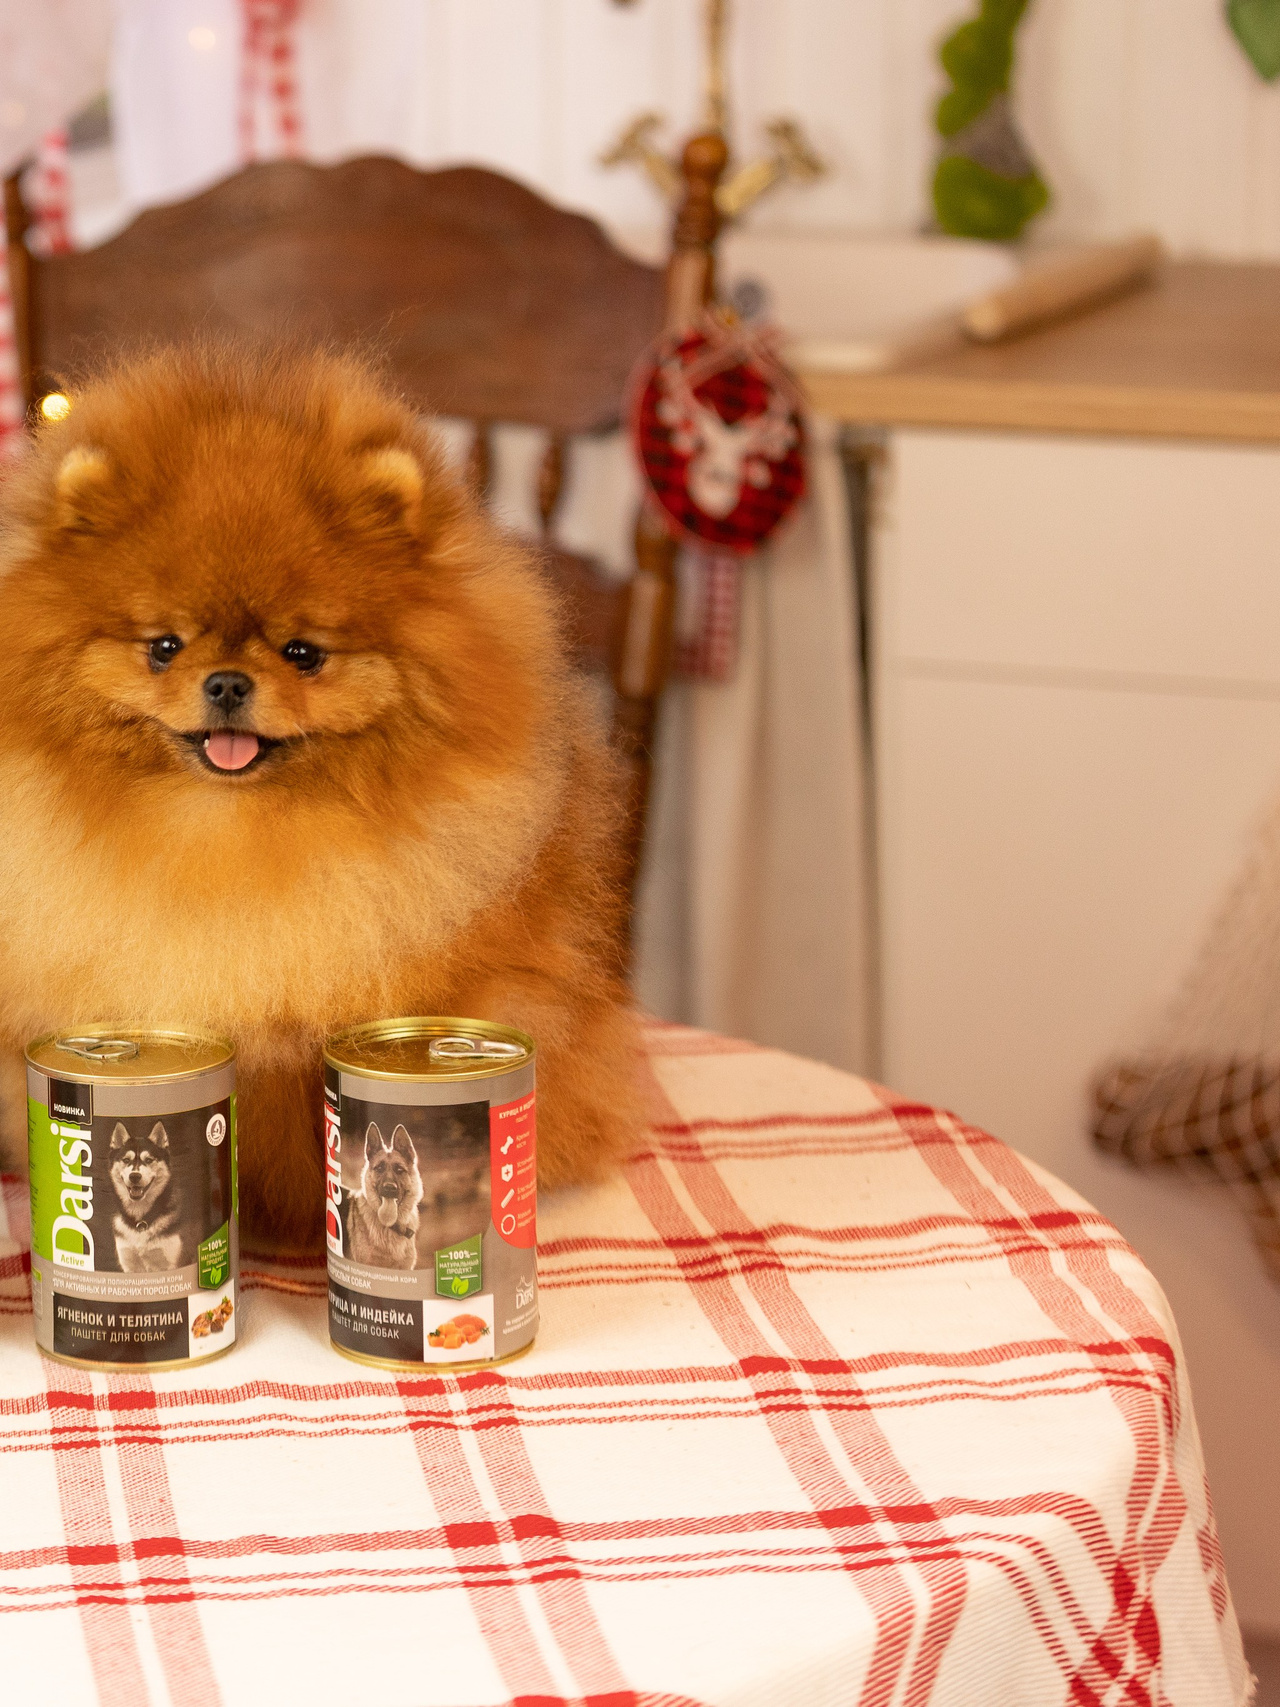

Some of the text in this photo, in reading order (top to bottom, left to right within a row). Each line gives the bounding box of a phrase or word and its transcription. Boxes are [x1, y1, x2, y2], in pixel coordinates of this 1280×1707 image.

[53, 1103, 85, 1117] НОВИНКА
[324, 1101, 344, 1258] Darsi
[50, 1122, 95, 1272] Darsi
[60, 1254, 85, 1267] Active
[449, 1250, 470, 1260] 100%
[167, 1274, 183, 1283] КОРМ
[351, 1275, 372, 1289] СОБАК
[400, 1276, 418, 1284] КОРМ
[66, 1281, 99, 1295] АКТИВНЫХ
[100, 1286, 107, 1295] И
[107, 1286, 142, 1297] РАБОЧИХ
[143, 1284, 170, 1296] ПОРОД
[170, 1282, 192, 1294] СОБАК
[57, 1305, 183, 1328] ЯГНЕНОК И ТЕЛЯТИНА
[350, 1303, 358, 1317] И
[360, 1305, 414, 1326] ИНДЕЙКА
[71, 1327, 166, 1343] ПАШТЕТ ДЛЯ СОБАК
[352, 1321, 368, 1334] ДЛЯ
[370, 1325, 400, 1340] СОБАК
